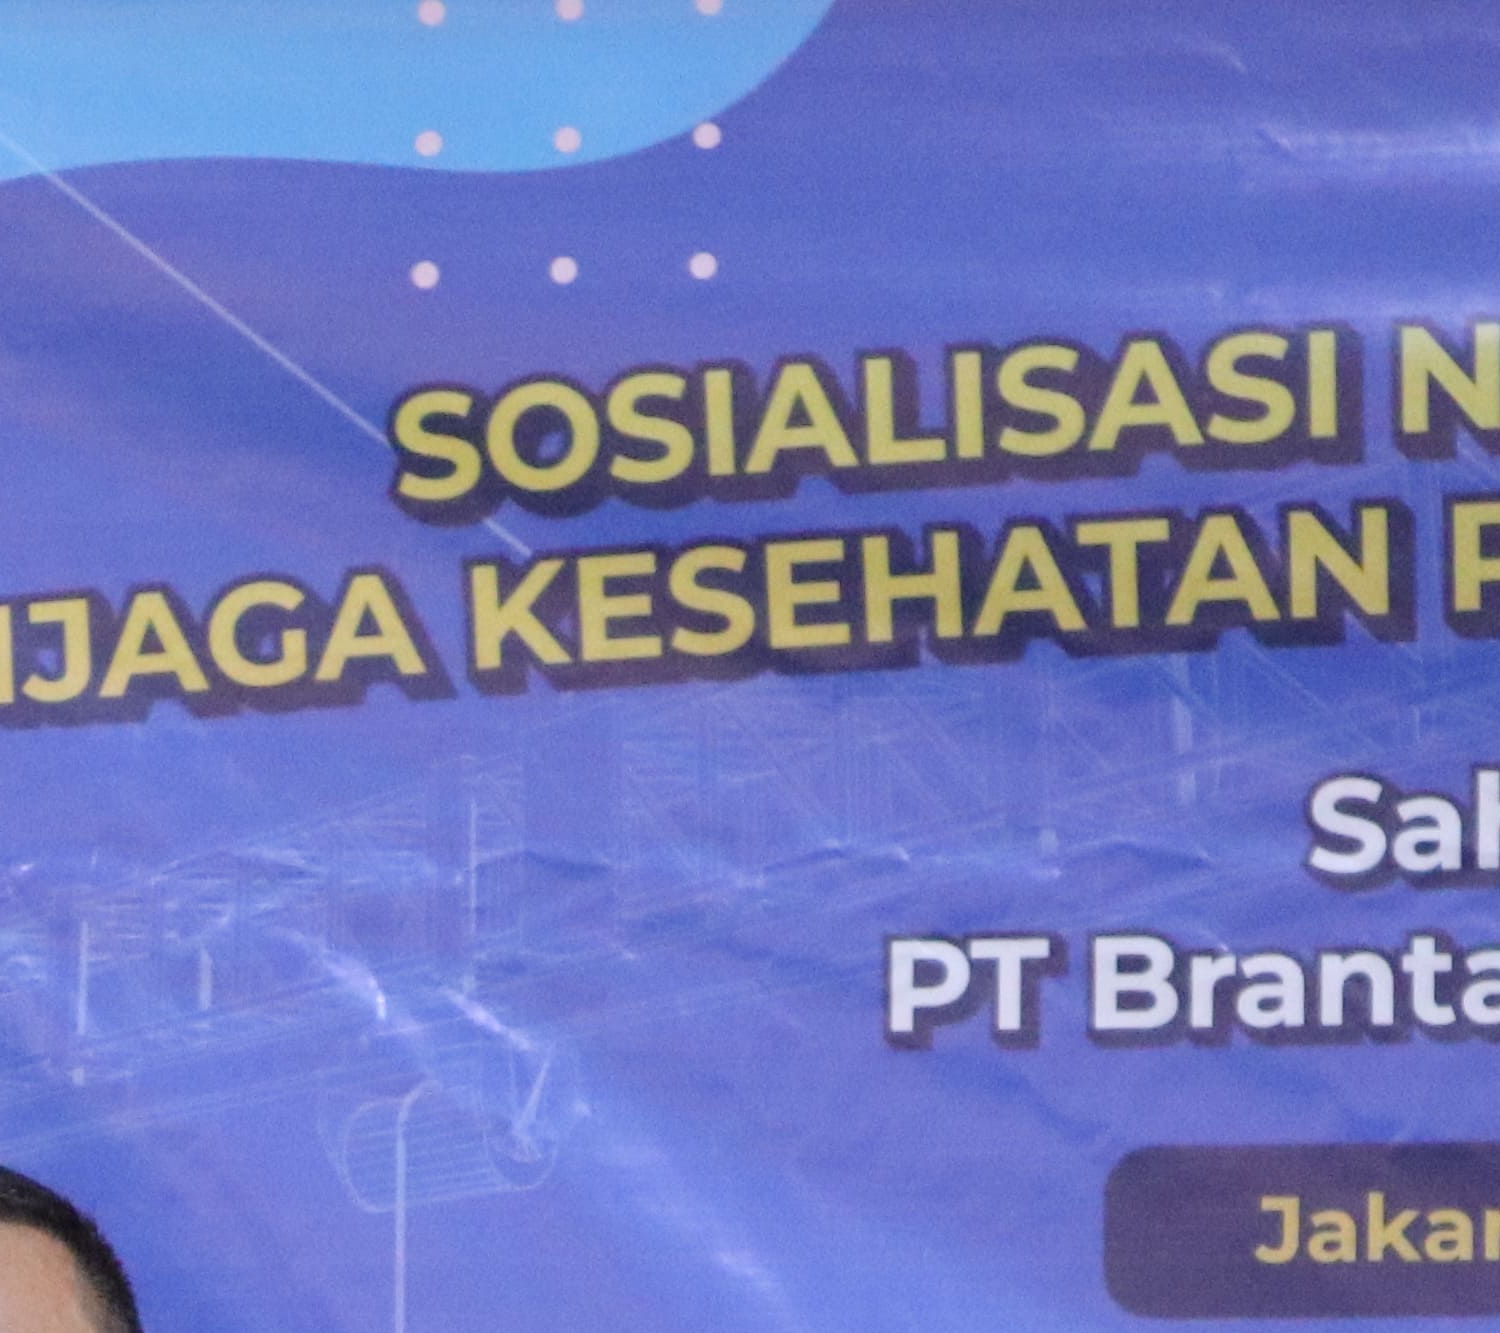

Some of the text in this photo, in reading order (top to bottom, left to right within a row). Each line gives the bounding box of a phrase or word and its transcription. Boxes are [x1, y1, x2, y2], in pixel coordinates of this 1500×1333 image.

[394, 325, 1337, 500] SOSIALISASI
[472, 505, 1390, 669] KESEHATAN
[886, 936, 1050, 1033] PT
